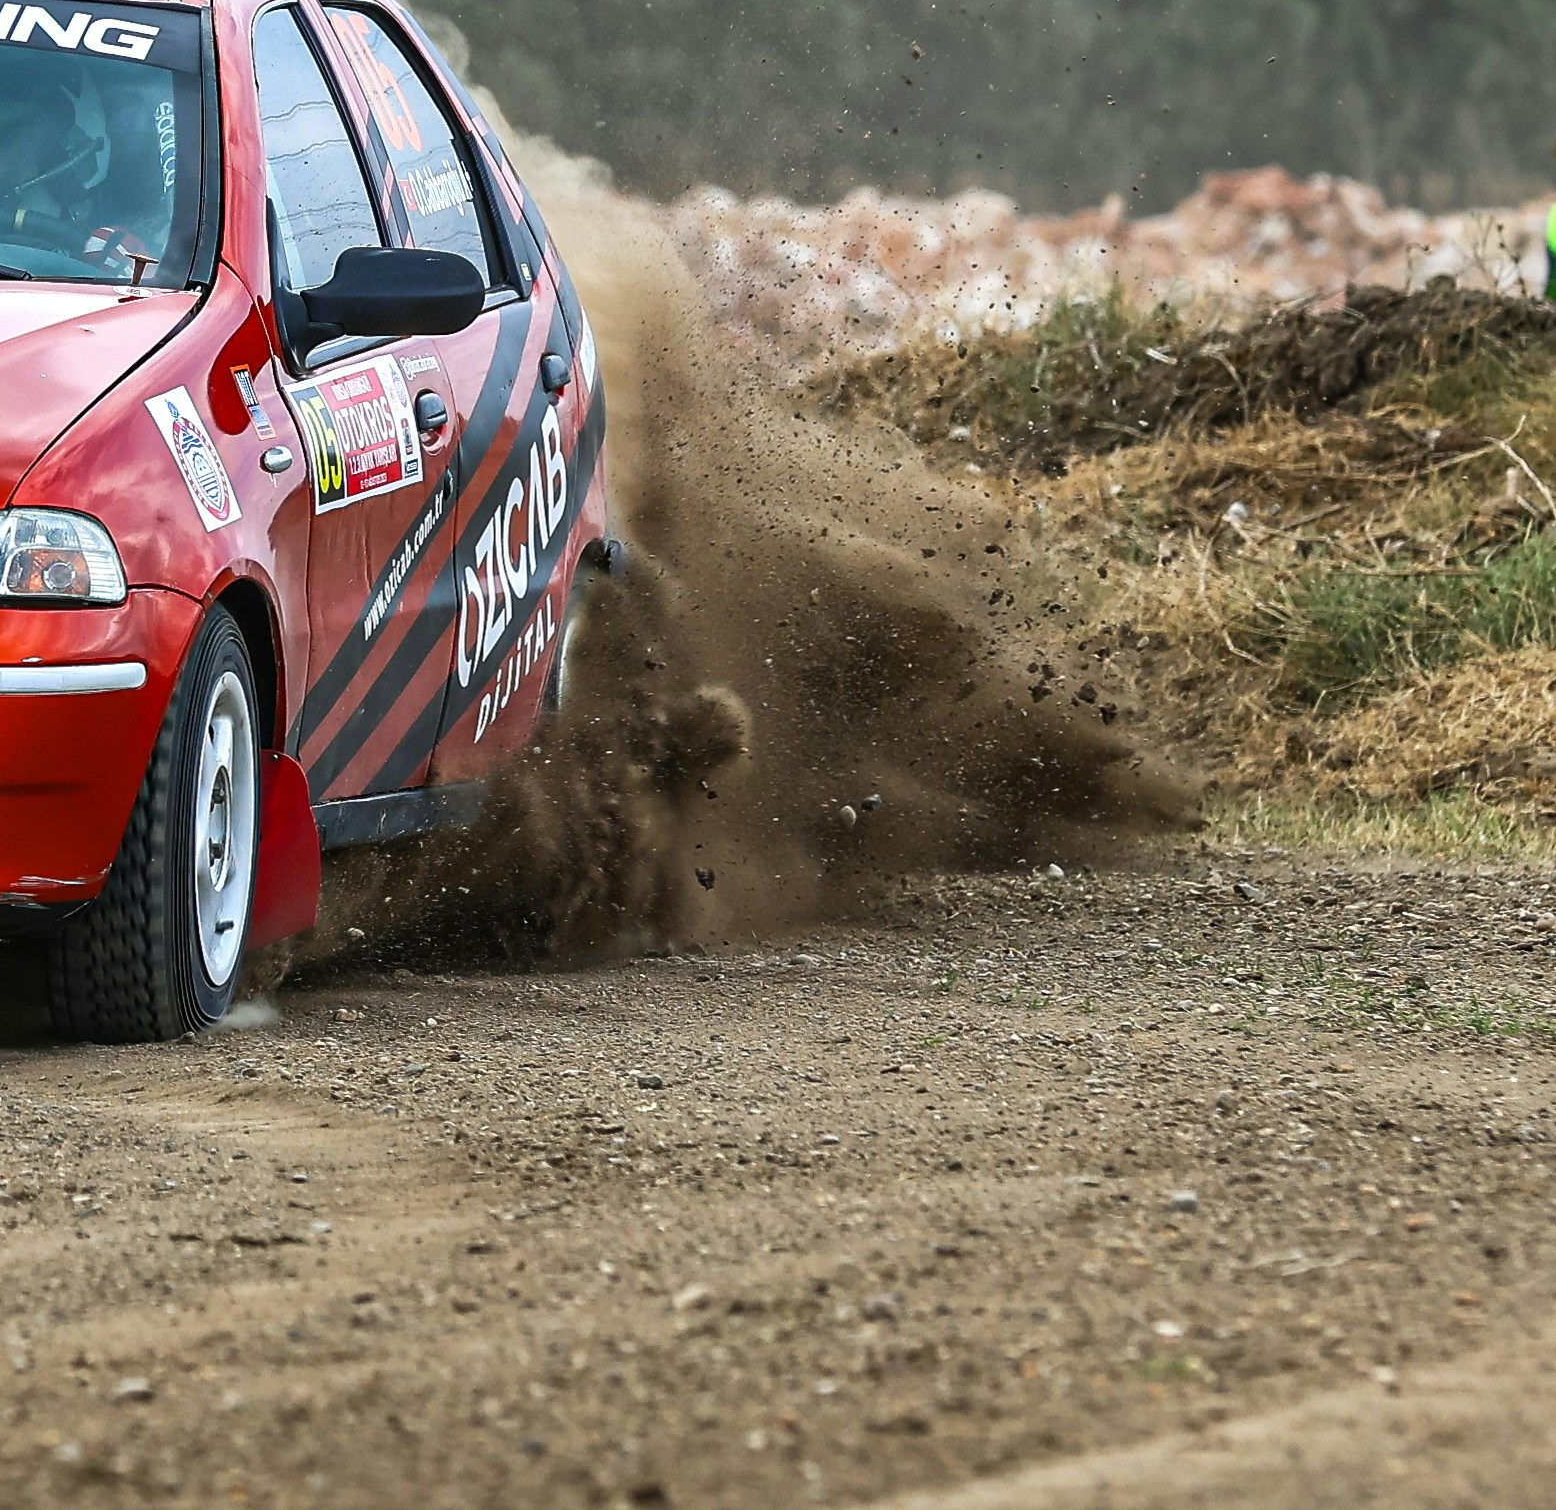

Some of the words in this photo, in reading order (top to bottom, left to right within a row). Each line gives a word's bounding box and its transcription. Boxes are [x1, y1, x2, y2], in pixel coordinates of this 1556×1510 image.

[300, 396, 343, 494] 05
[334, 396, 396, 454] OTOKROS
[363, 489, 444, 641] www.ozicab.com.tr
[457, 404, 568, 689] OZICAB
